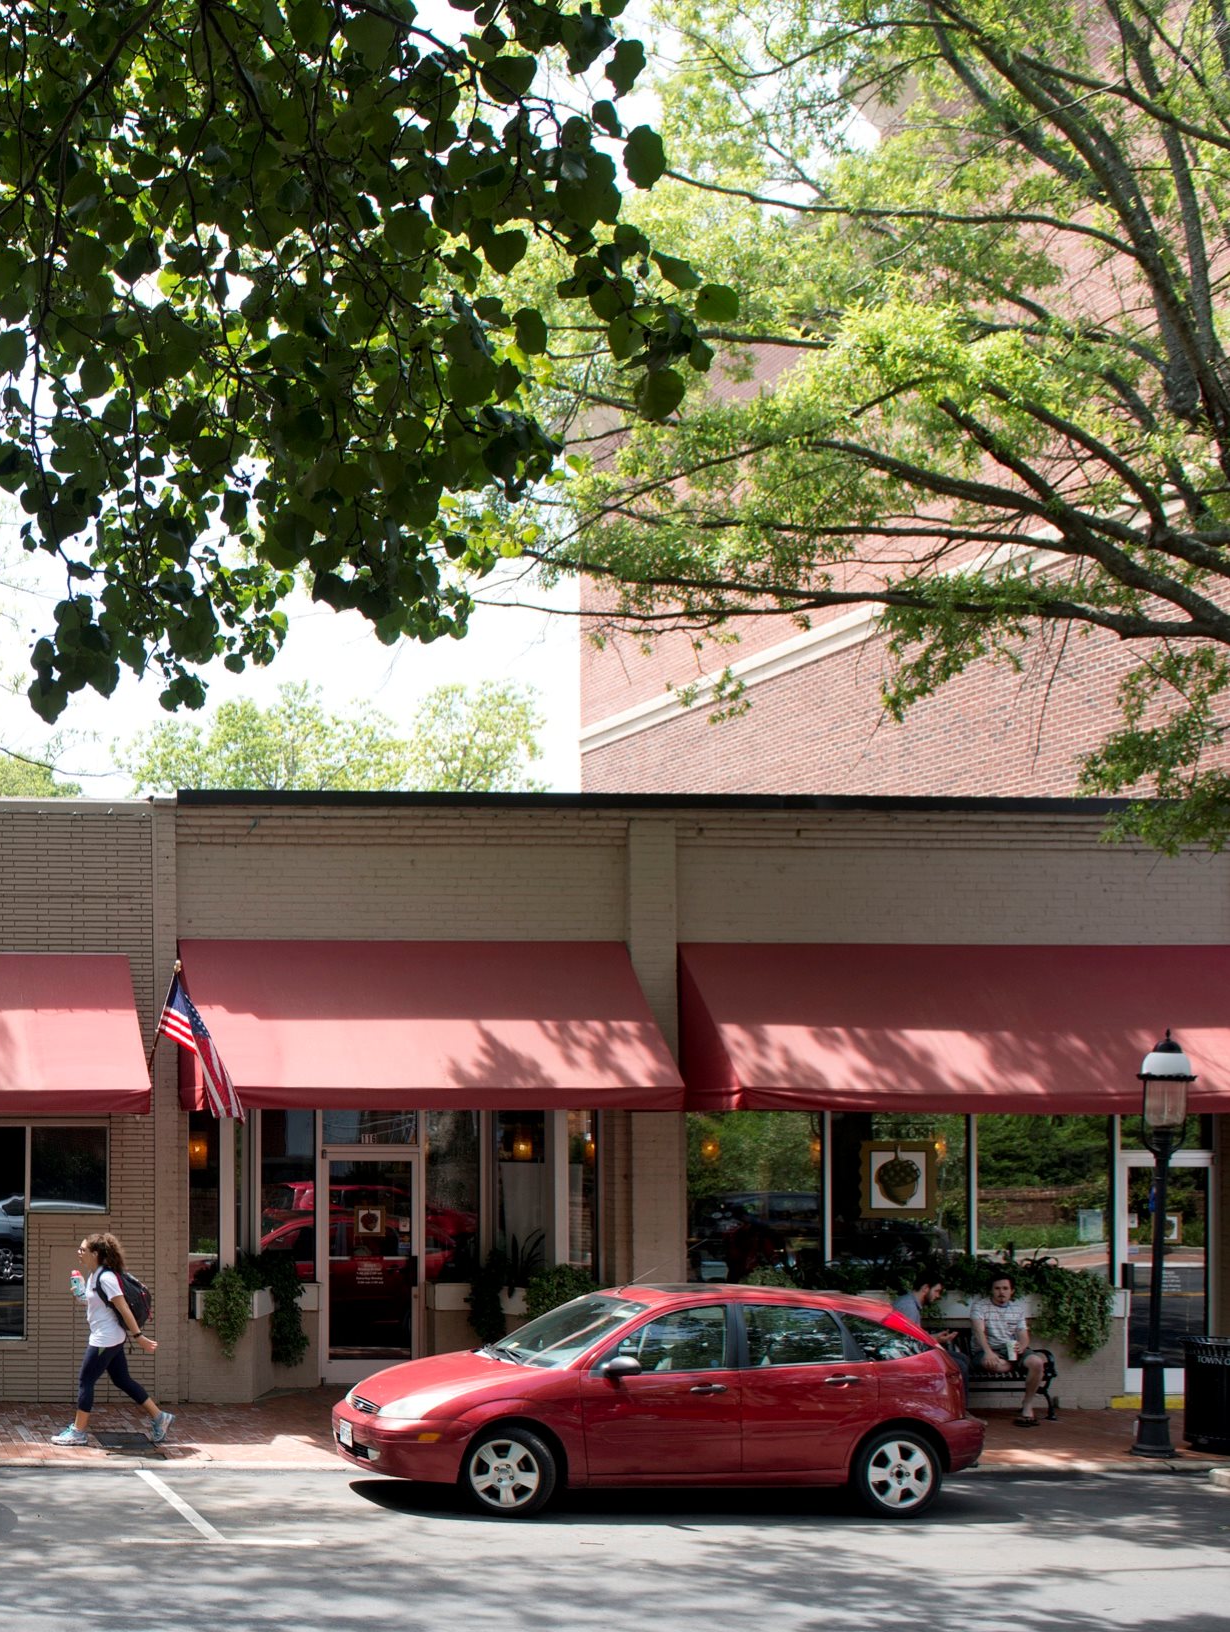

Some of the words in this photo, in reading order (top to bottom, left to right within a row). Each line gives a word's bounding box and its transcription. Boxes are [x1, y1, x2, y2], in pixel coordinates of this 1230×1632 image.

[363, 1134, 377, 1144] 116
[1197, 1355, 1223, 1366] TOWN
[1224, 1358, 1230, 1366] O
